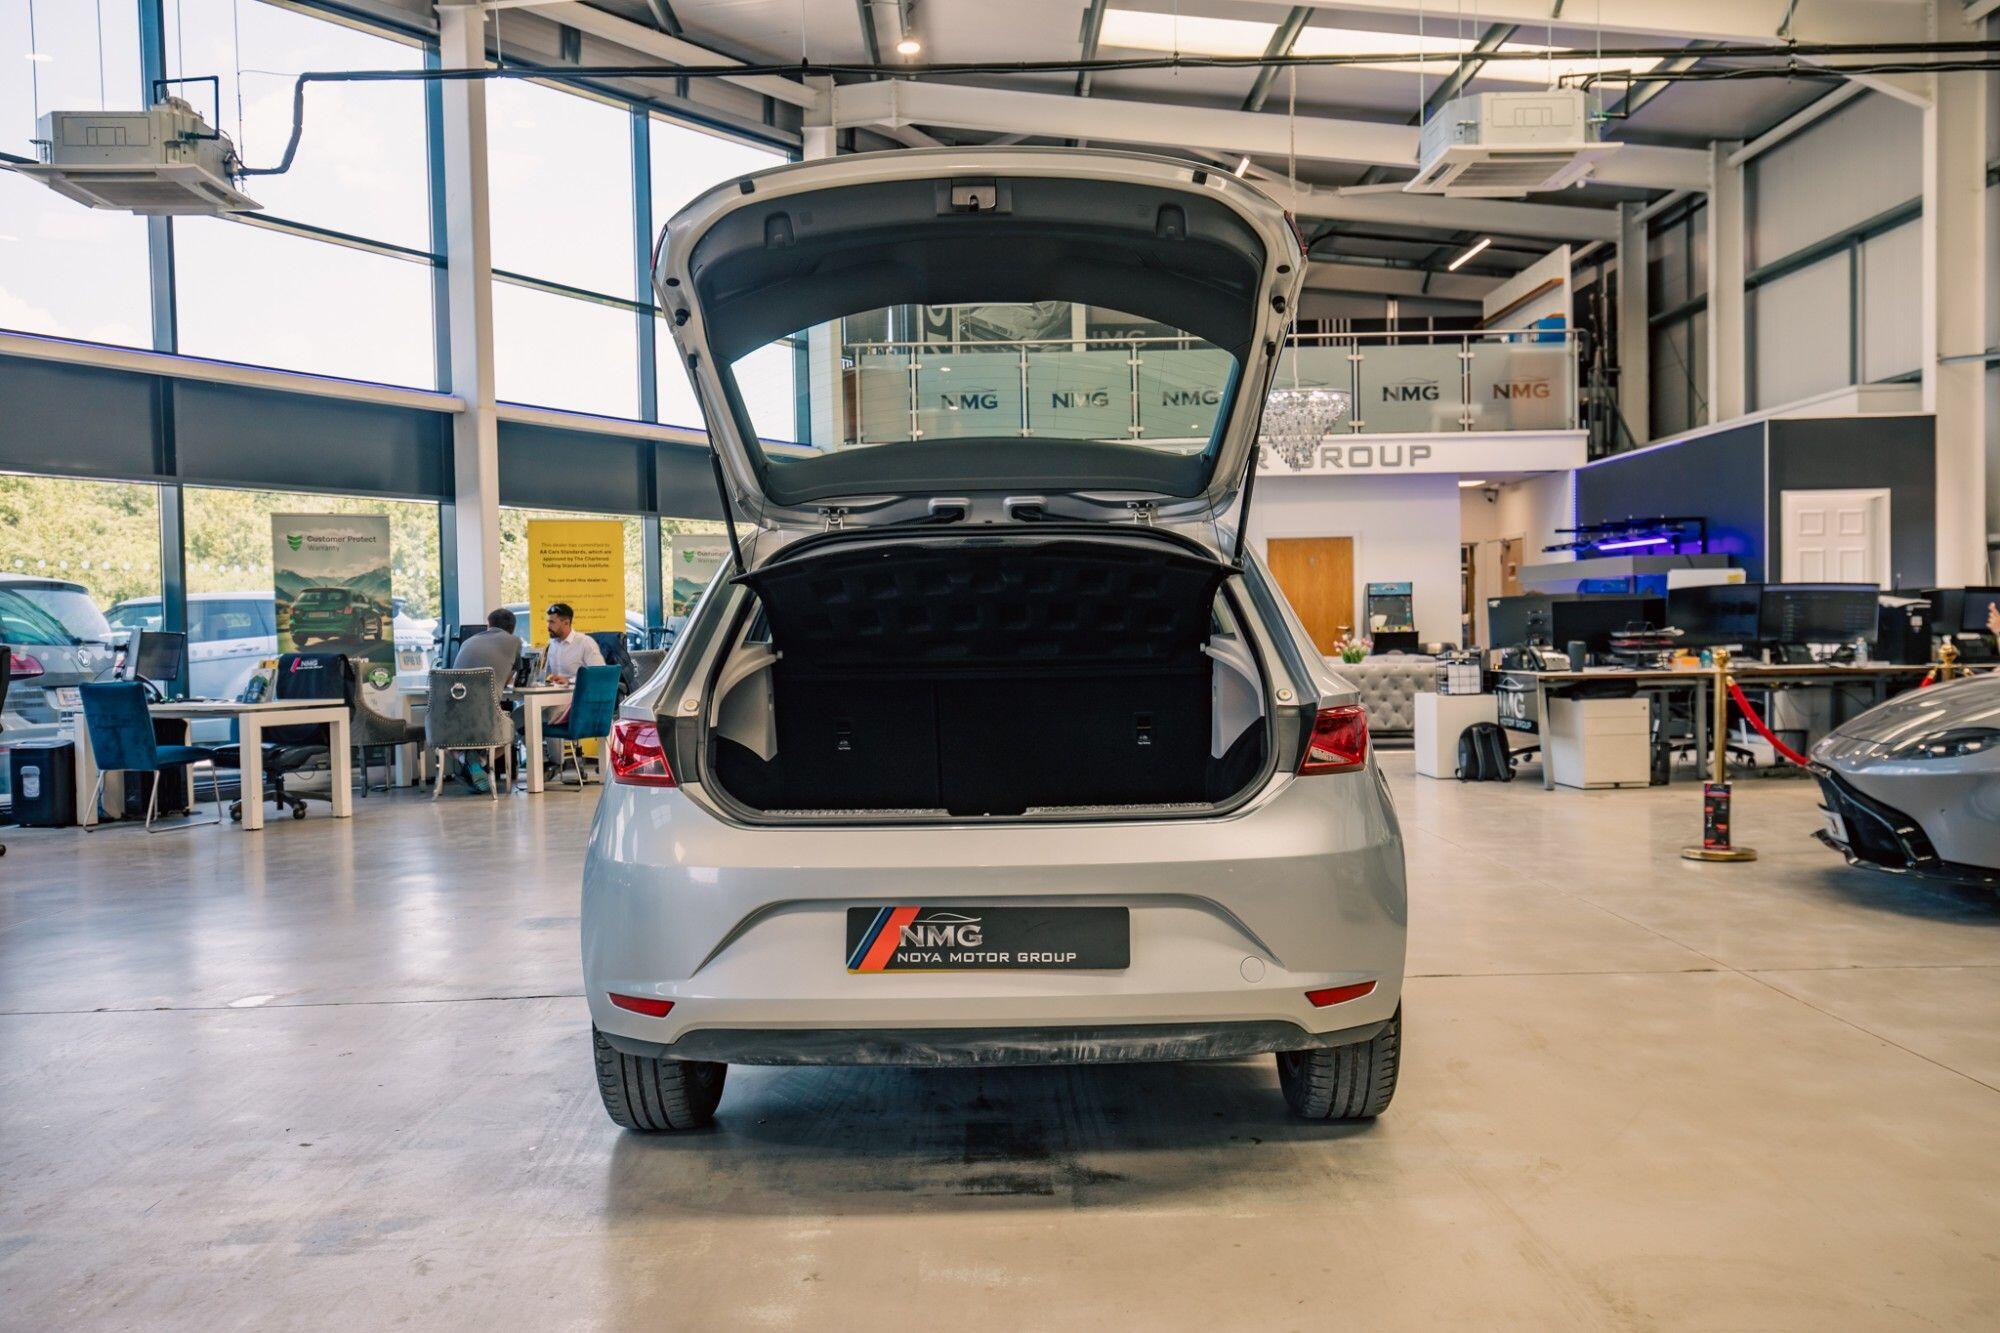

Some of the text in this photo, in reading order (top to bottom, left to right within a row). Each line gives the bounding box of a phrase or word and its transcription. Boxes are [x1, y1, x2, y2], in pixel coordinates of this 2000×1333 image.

[1052, 391, 1109, 408] NMG
[1162, 389, 1219, 407] NMG
[1382, 385, 1439, 402] NMG
[1493, 382, 1551, 400] NMG
[941, 393, 998, 410] NMG
[307, 535, 377, 543] Customer Protect
[899, 925, 983, 947] NMG
[897, 952, 1077, 963] NOYA MOTOR GROUP
